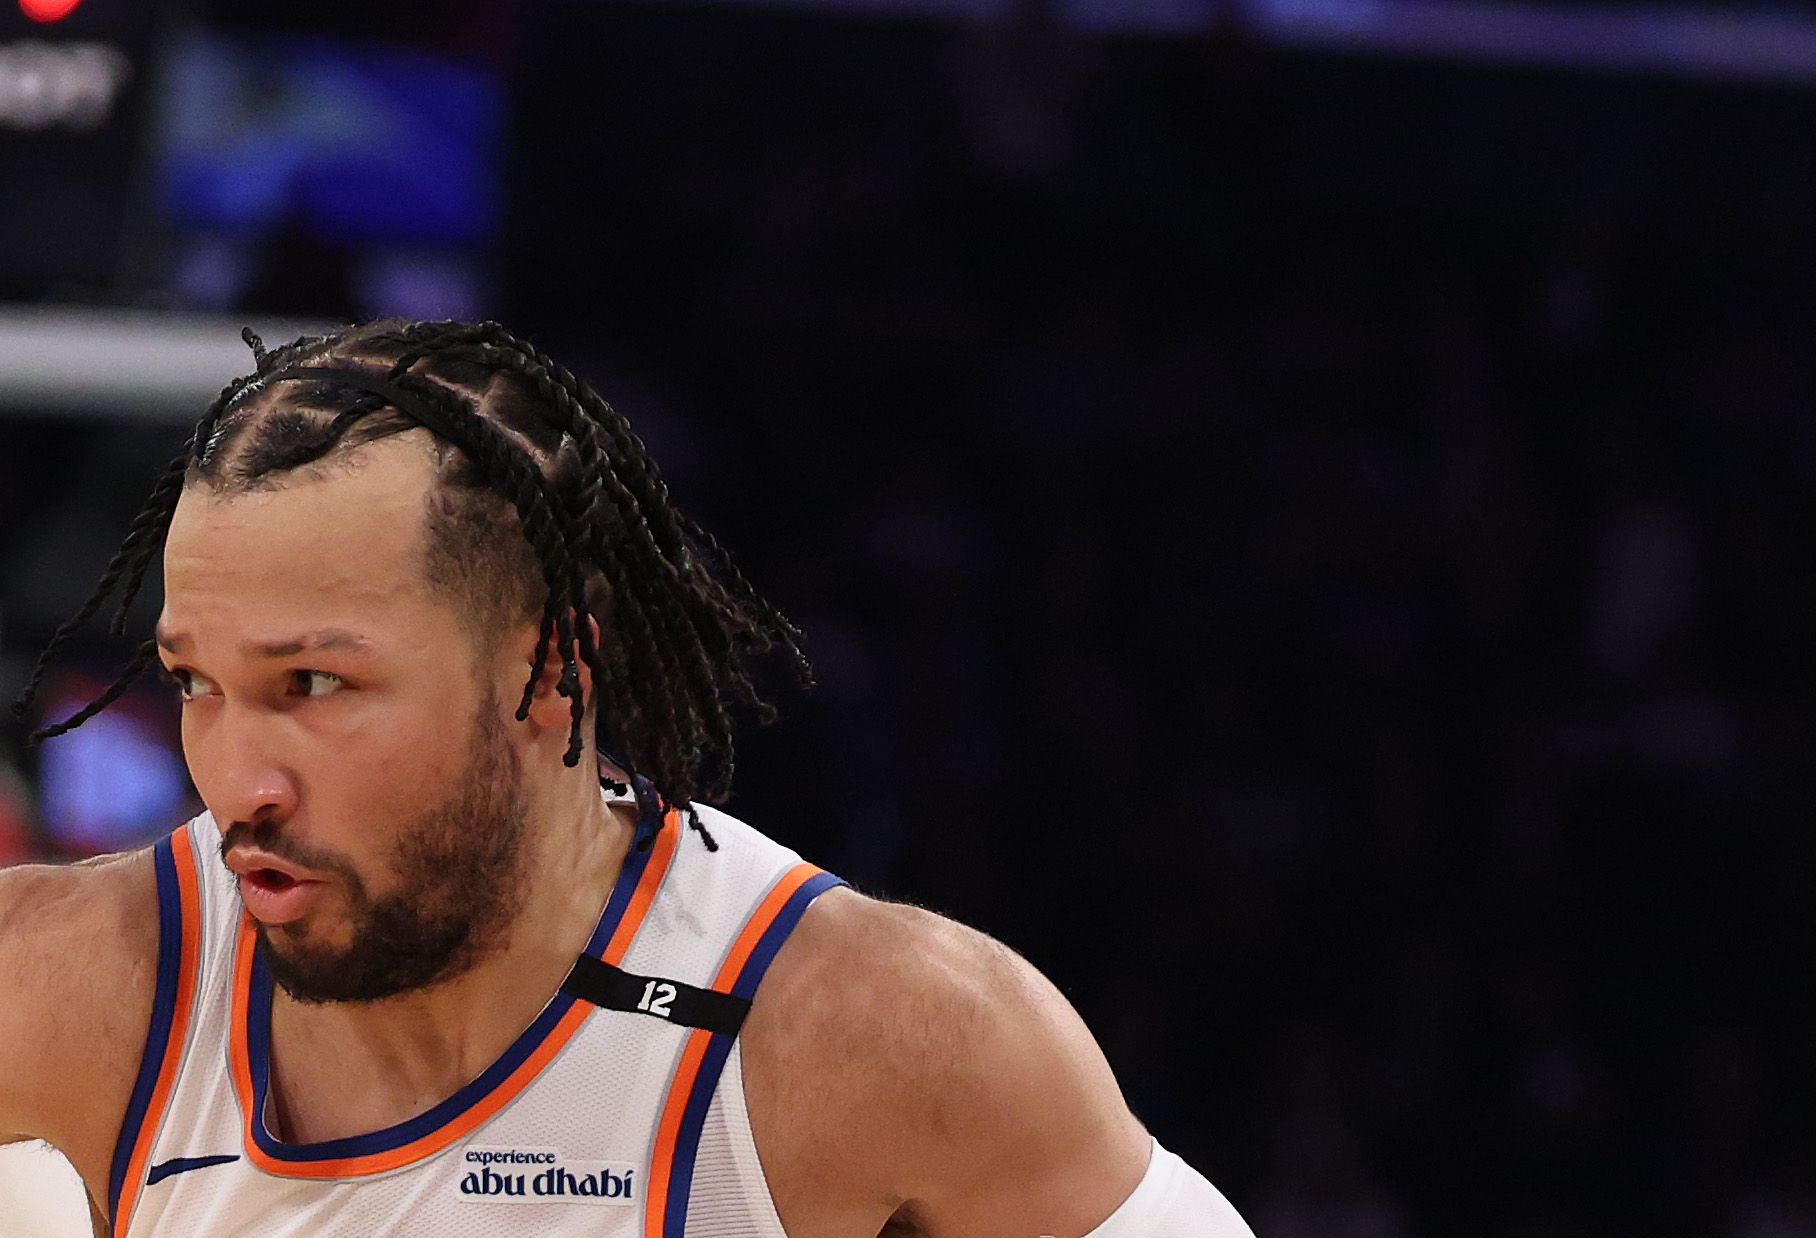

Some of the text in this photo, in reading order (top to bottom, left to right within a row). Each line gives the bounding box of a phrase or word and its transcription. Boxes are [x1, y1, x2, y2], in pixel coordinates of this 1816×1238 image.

[637, 981, 677, 1017] 12
[465, 1149, 556, 1166] experience
[460, 1167, 526, 1196] abu
